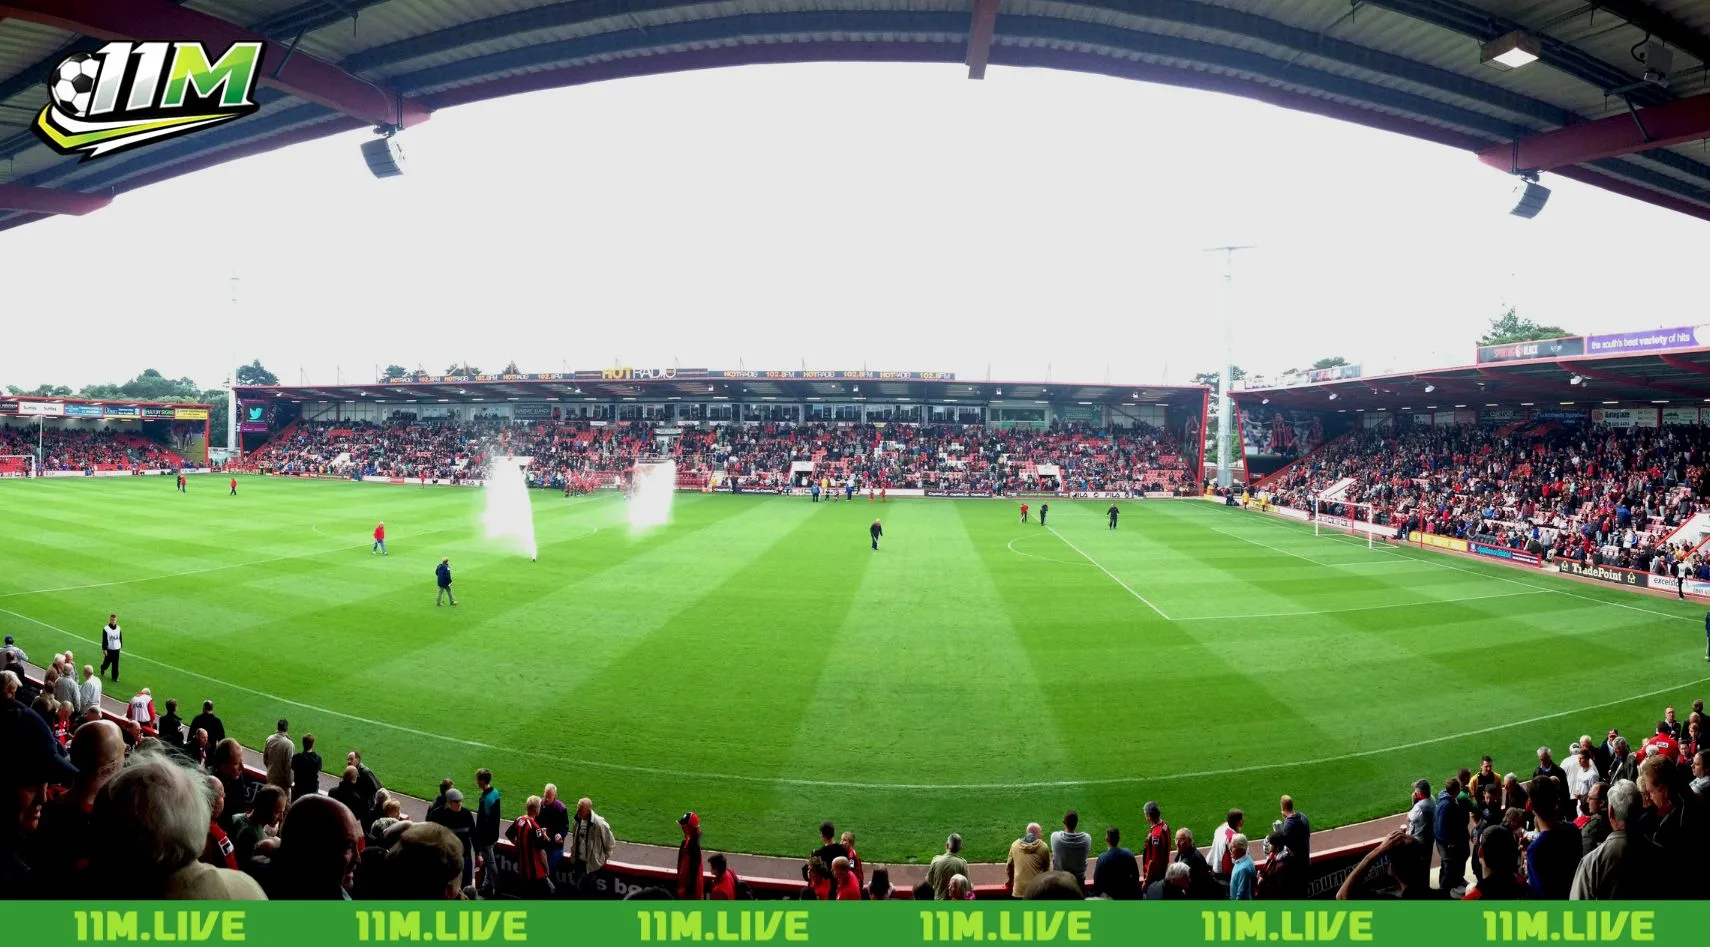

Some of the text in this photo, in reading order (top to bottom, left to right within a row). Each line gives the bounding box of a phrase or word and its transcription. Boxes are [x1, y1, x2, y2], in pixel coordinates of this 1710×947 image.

[1591, 341, 1601, 350] the
[1624, 338, 1639, 347] best
[1640, 334, 1668, 346] variety
[1669, 333, 1677, 342] of
[1677, 332, 1690, 342] hits
